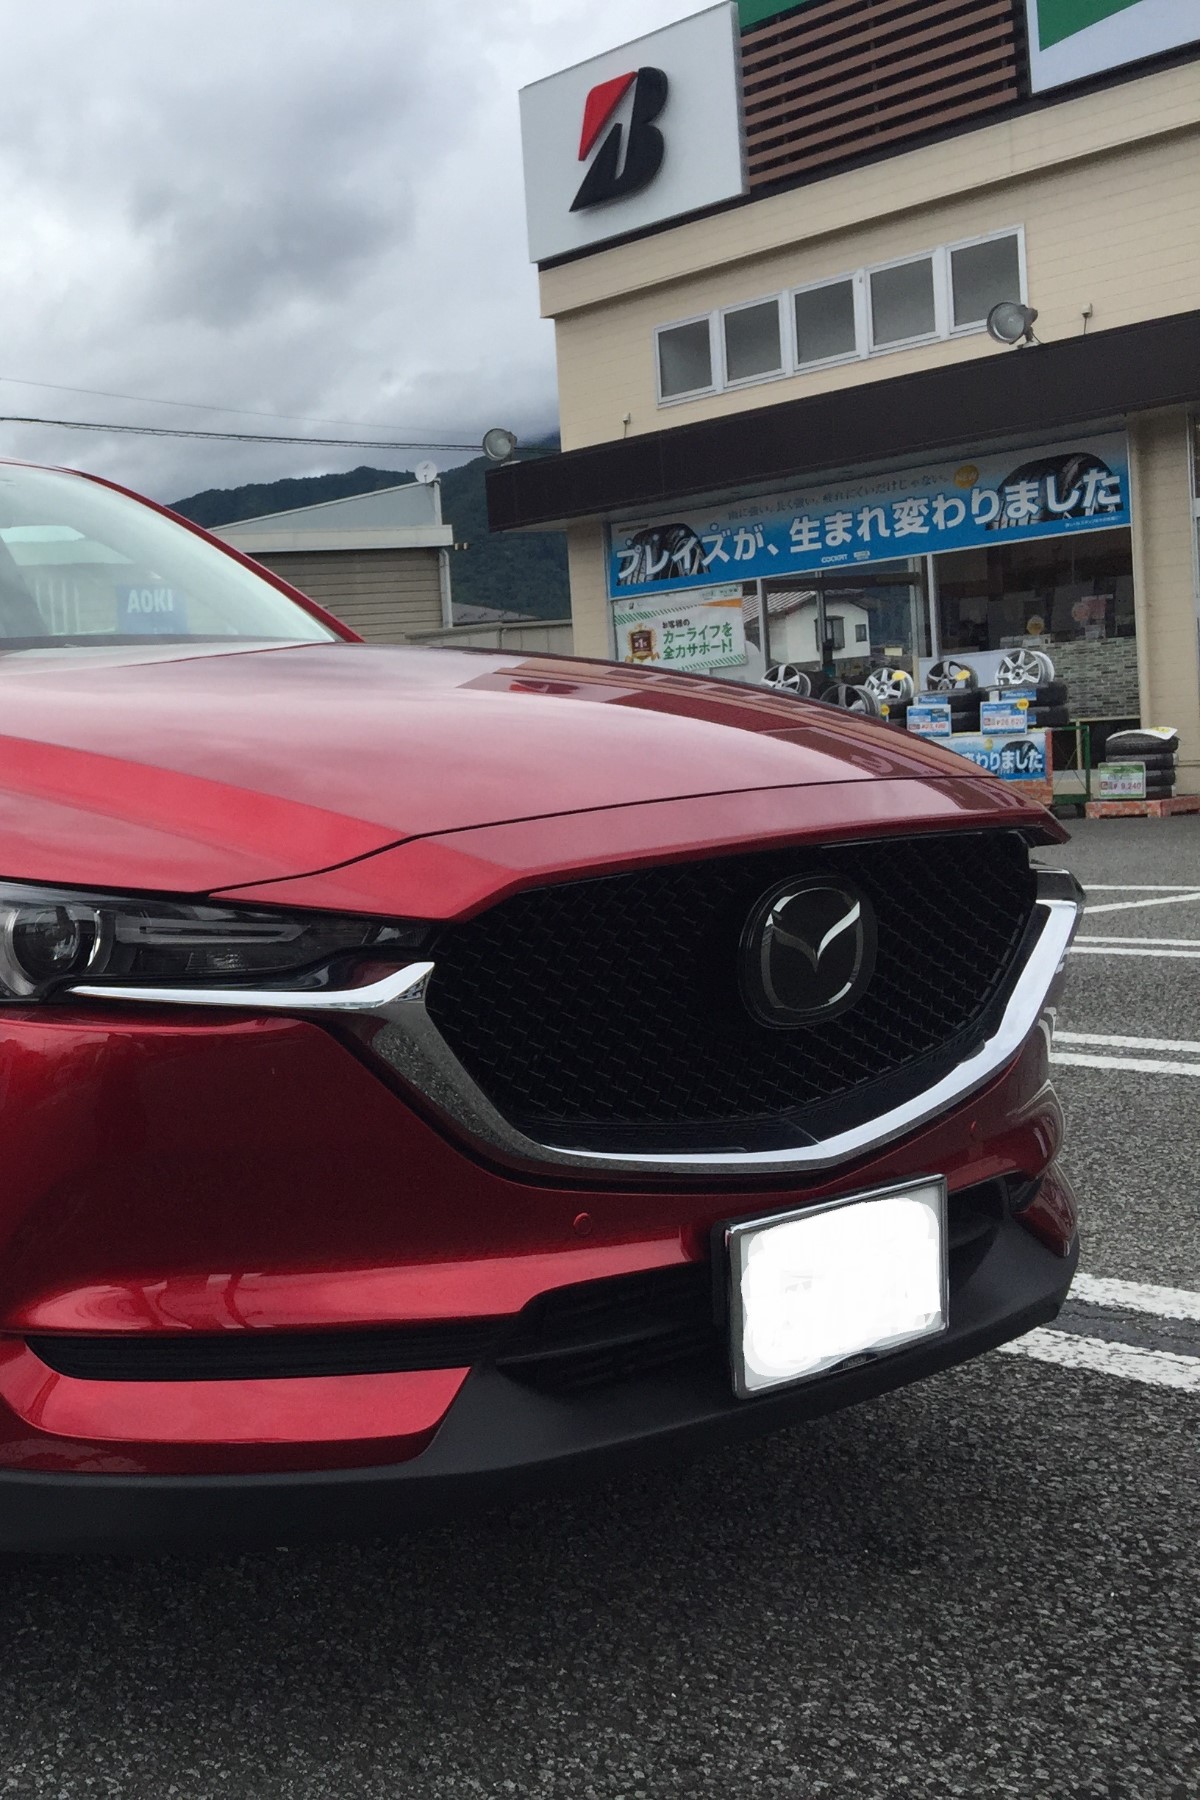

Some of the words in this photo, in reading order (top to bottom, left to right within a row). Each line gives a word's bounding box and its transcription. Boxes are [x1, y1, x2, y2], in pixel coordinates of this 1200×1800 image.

[616, 468, 1121, 579] プレイズが、生まれ変わりました
[127, 588, 174, 614] AOKI
[663, 621, 733, 645] カーライフを
